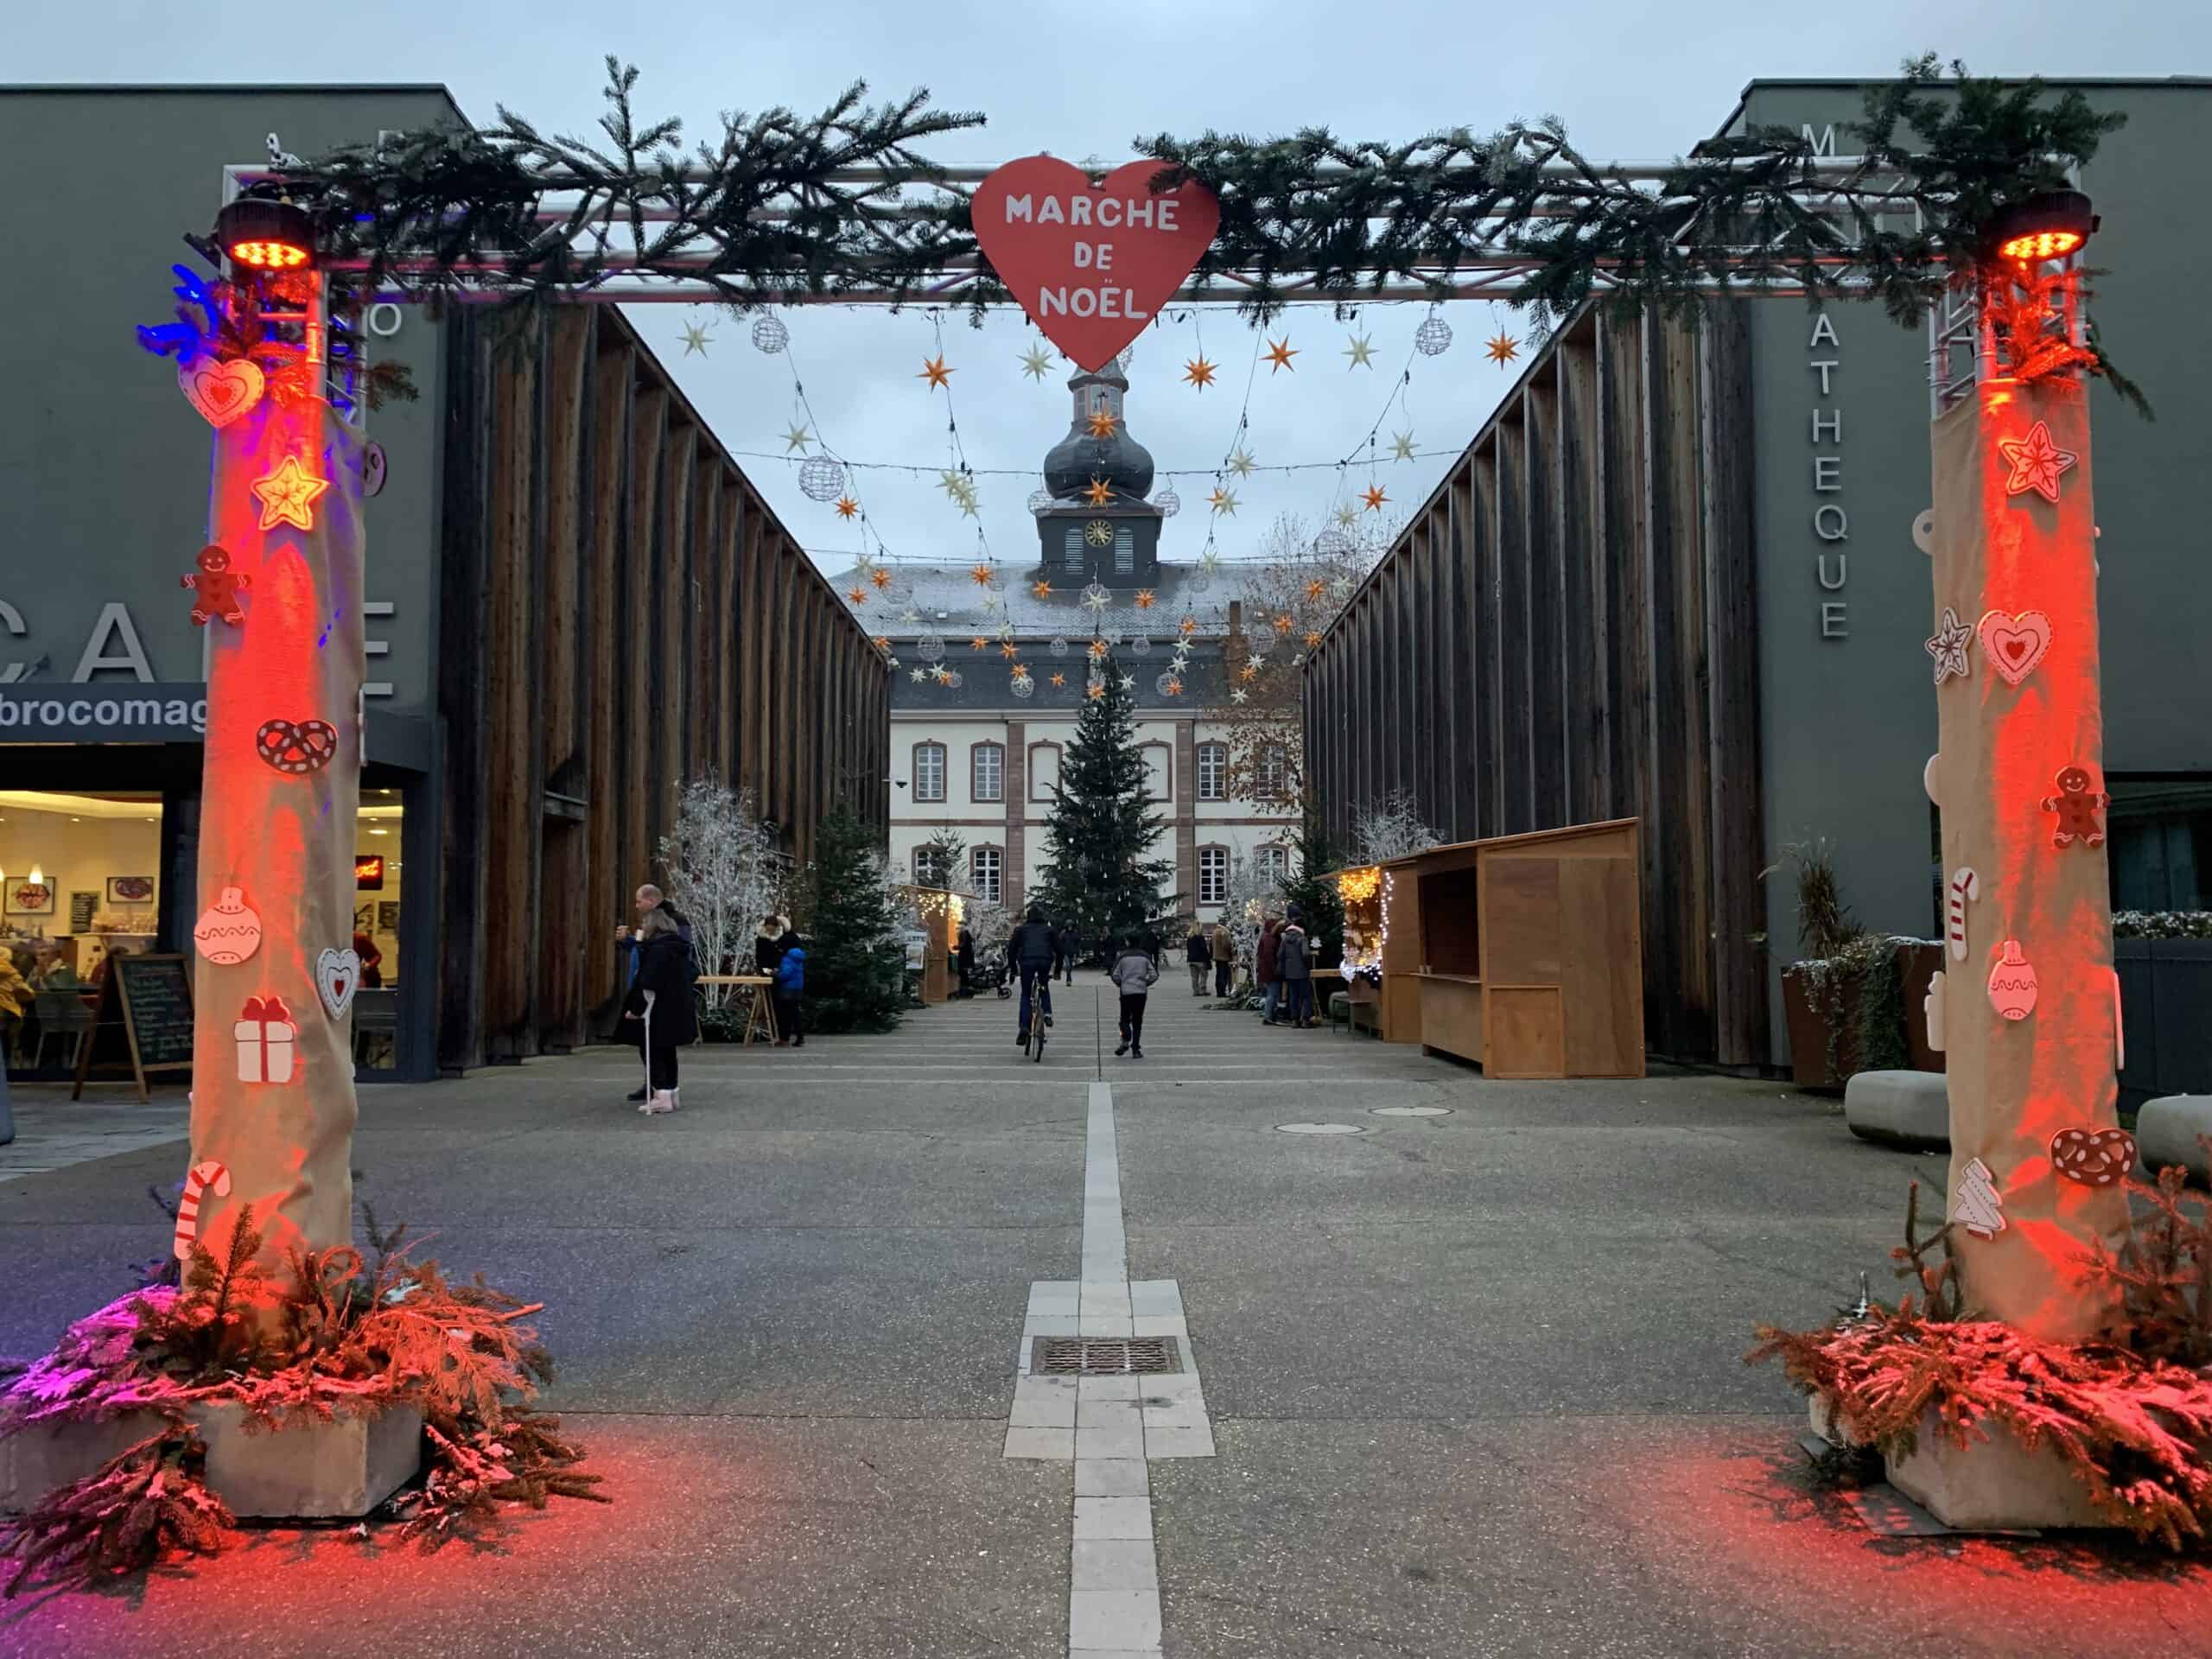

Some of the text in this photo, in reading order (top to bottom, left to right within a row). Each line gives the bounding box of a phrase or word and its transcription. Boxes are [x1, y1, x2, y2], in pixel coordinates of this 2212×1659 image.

[1074, 241, 1113, 270] DE
[1039, 277, 1147, 319] NOËL
[1802, 124, 1848, 637] MATHEQUE
